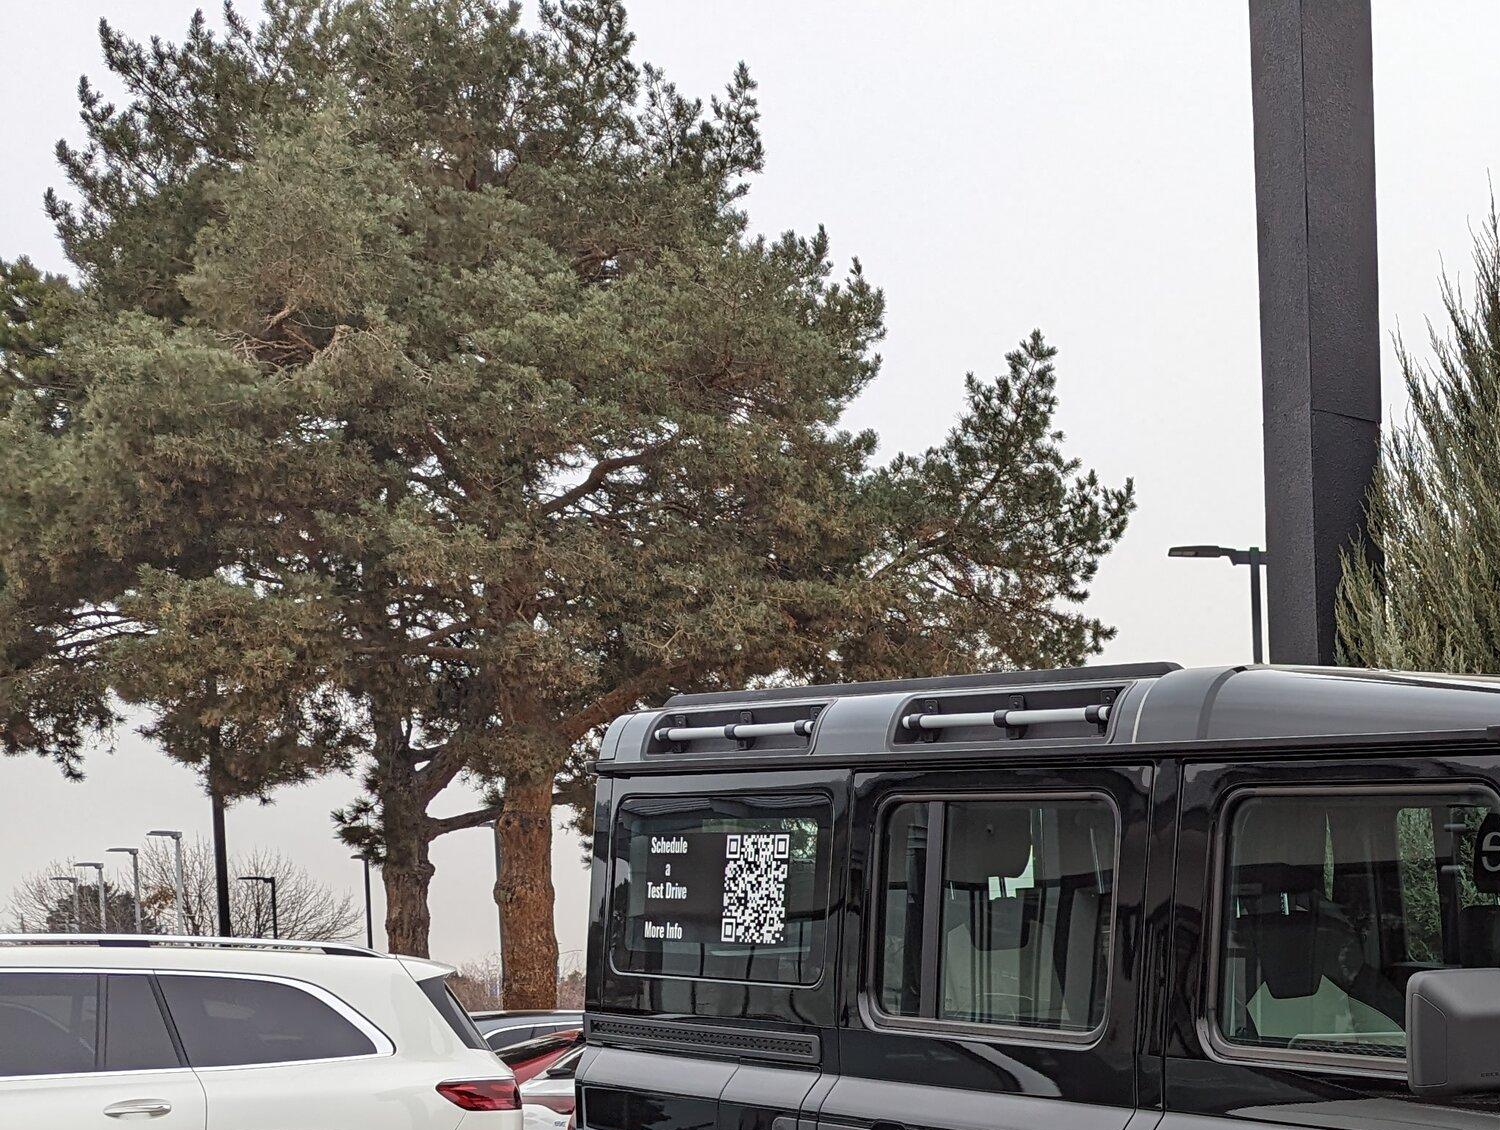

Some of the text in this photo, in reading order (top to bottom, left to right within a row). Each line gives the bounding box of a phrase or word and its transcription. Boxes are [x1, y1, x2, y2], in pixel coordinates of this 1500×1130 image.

[651, 836, 688, 854] Schedule
[664, 863, 671, 876] a
[647, 881, 687, 900] Test Drive
[644, 921, 683, 939] More Info
